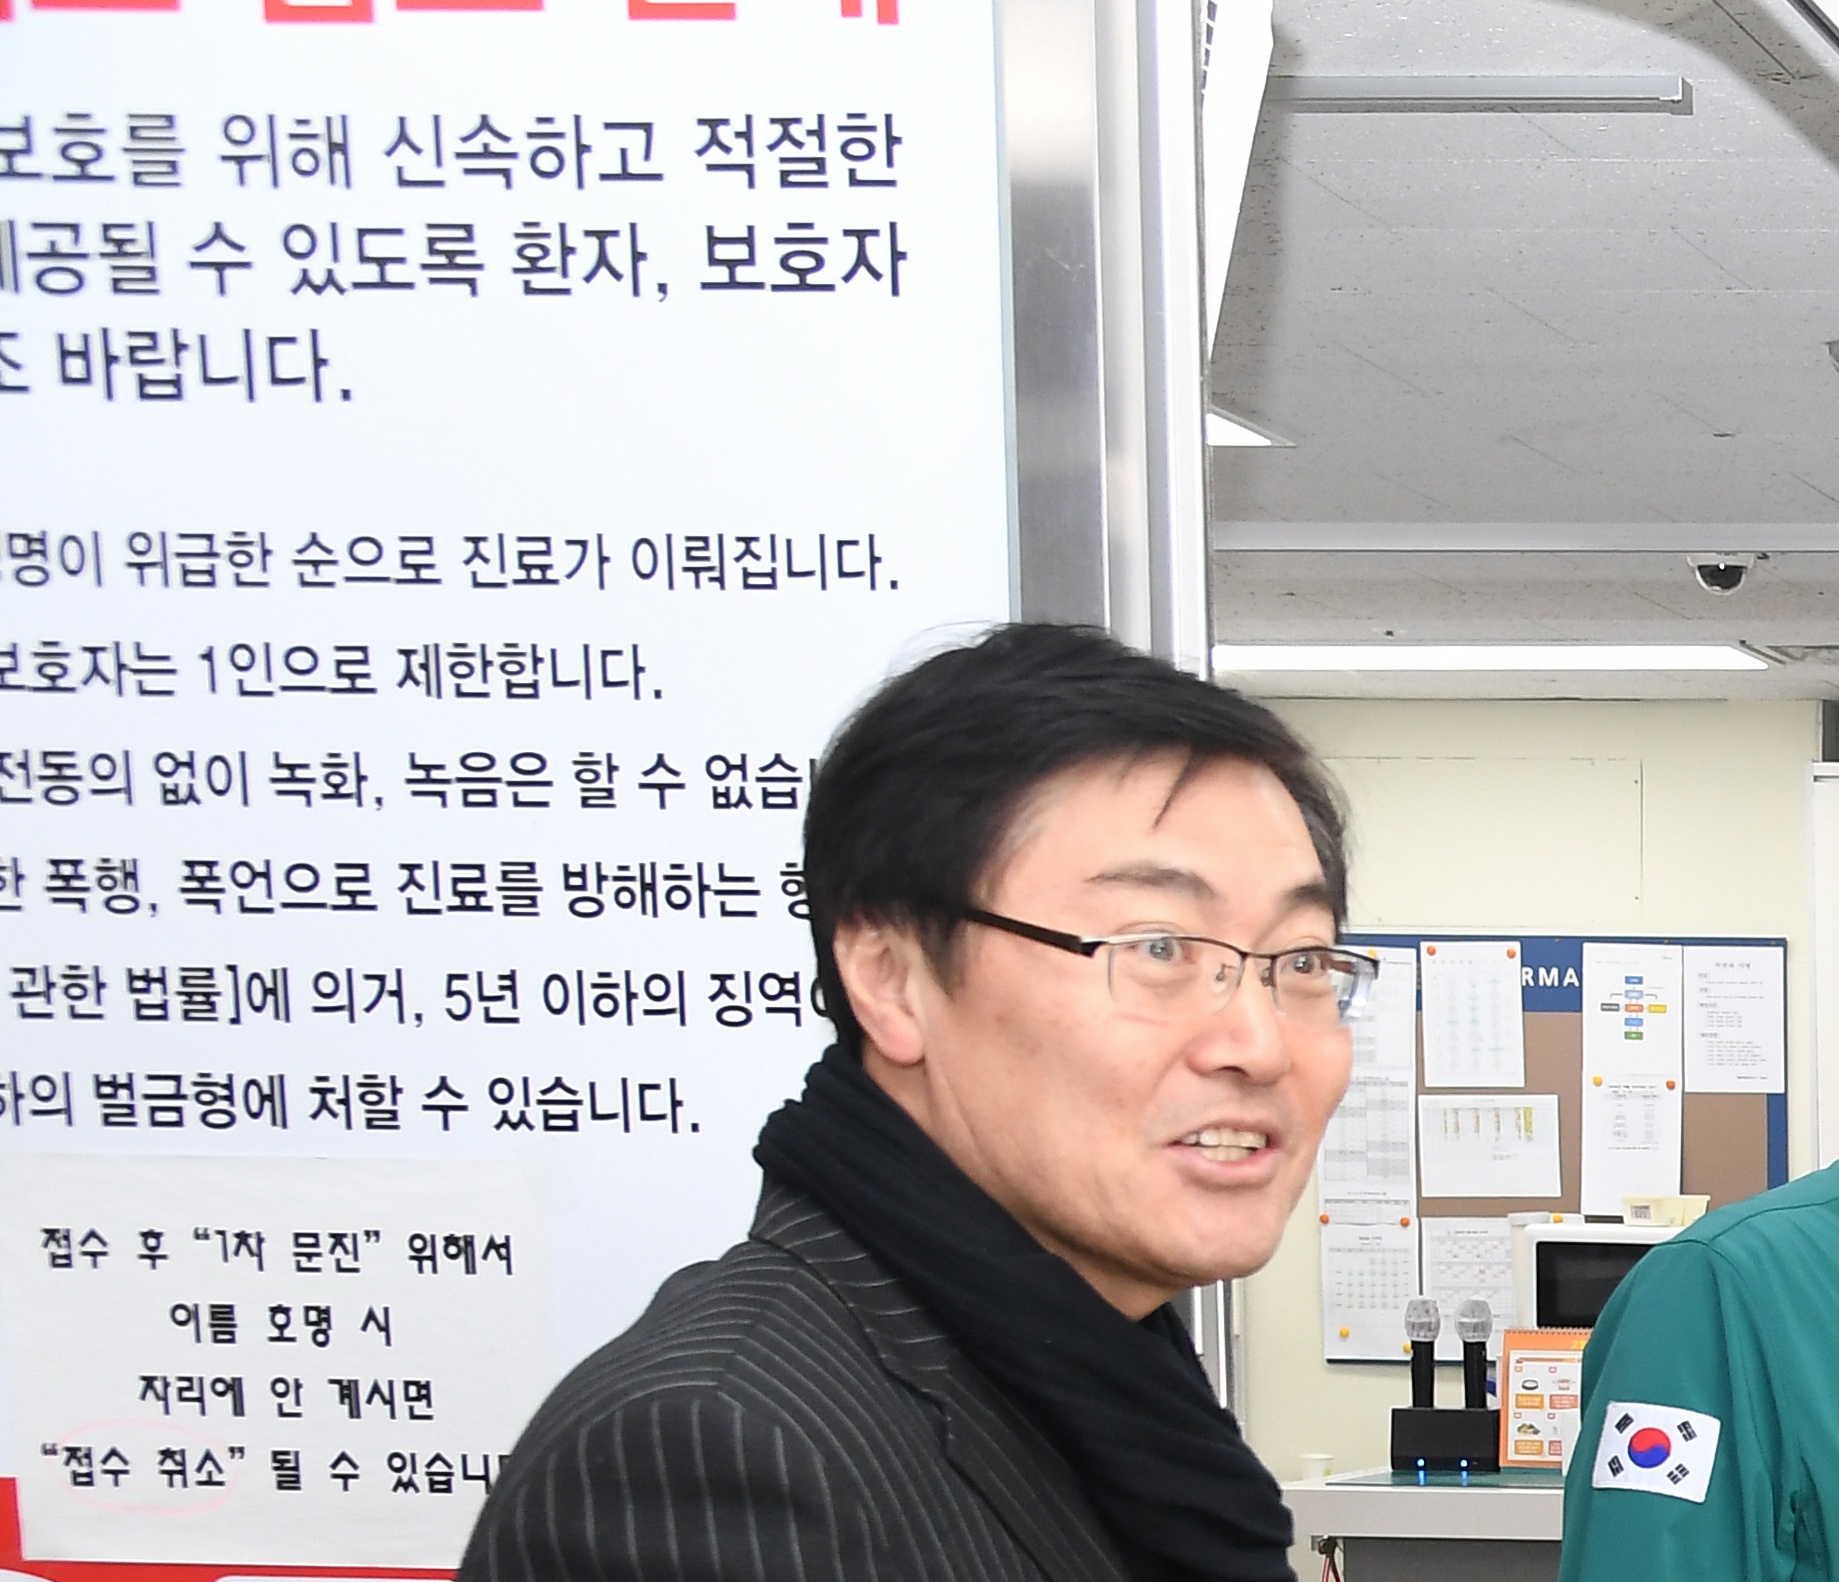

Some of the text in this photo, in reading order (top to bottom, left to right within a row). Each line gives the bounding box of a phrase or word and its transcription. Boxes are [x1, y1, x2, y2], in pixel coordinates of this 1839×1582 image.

[220, 114, 351, 189] 위해
[385, 114, 663, 190] 신속하고
[695, 113, 902, 189] 적절한
[189, 222, 252, 296] 수
[283, 222, 484, 297] 있도록
[512, 222, 667, 302] 환자,
[701, 222, 907, 296] 보호자
[57, 328, 351, 402] 바랍니다.
[8, 531, 898, 591] 명이 위급한 순으로 진료가 이뤄집니다.
[200, 643, 377, 697] 1인으로
[397, 643, 662, 700] 제한합니다.
[154, 751, 248, 806] 없이
[270, 752, 382, 810] 녹화,
[405, 752, 553, 808] 녹음은
[572, 752, 619, 808] 할
[639, 753, 685, 809] 수
[705, 753, 816, 809] 없습
[45, 858, 156, 914] 폭행,
[180, 860, 377, 914] 폭언으로
[398, 861, 543, 916] 진료를
[563, 862, 760, 918] 방해하는
[11, 965, 106, 1019] 관한
[127, 965, 290, 1025] 법률]에
[312, 968, 422, 1027] 의거,
[446, 969, 519, 1023] 5년
[543, 970, 686, 1026] 이하의
[94, 1073, 287, 1129] 벌금형에
[310, 1074, 403, 1130] 처할
[422, 1076, 468, 1131] 수
[489, 1077, 699, 1133] 있습니다.
[42, 1228, 108, 1268] 접수
[138, 1229, 168, 1269] 후
[409, 1233, 512, 1275] 위해서
[171, 1304, 391, 1347] 이름 호명 시
[140, 1376, 433, 1420] 자리에 안 계시면
[272, 1451, 301, 1490] 될
[330, 1452, 359, 1491] 수
